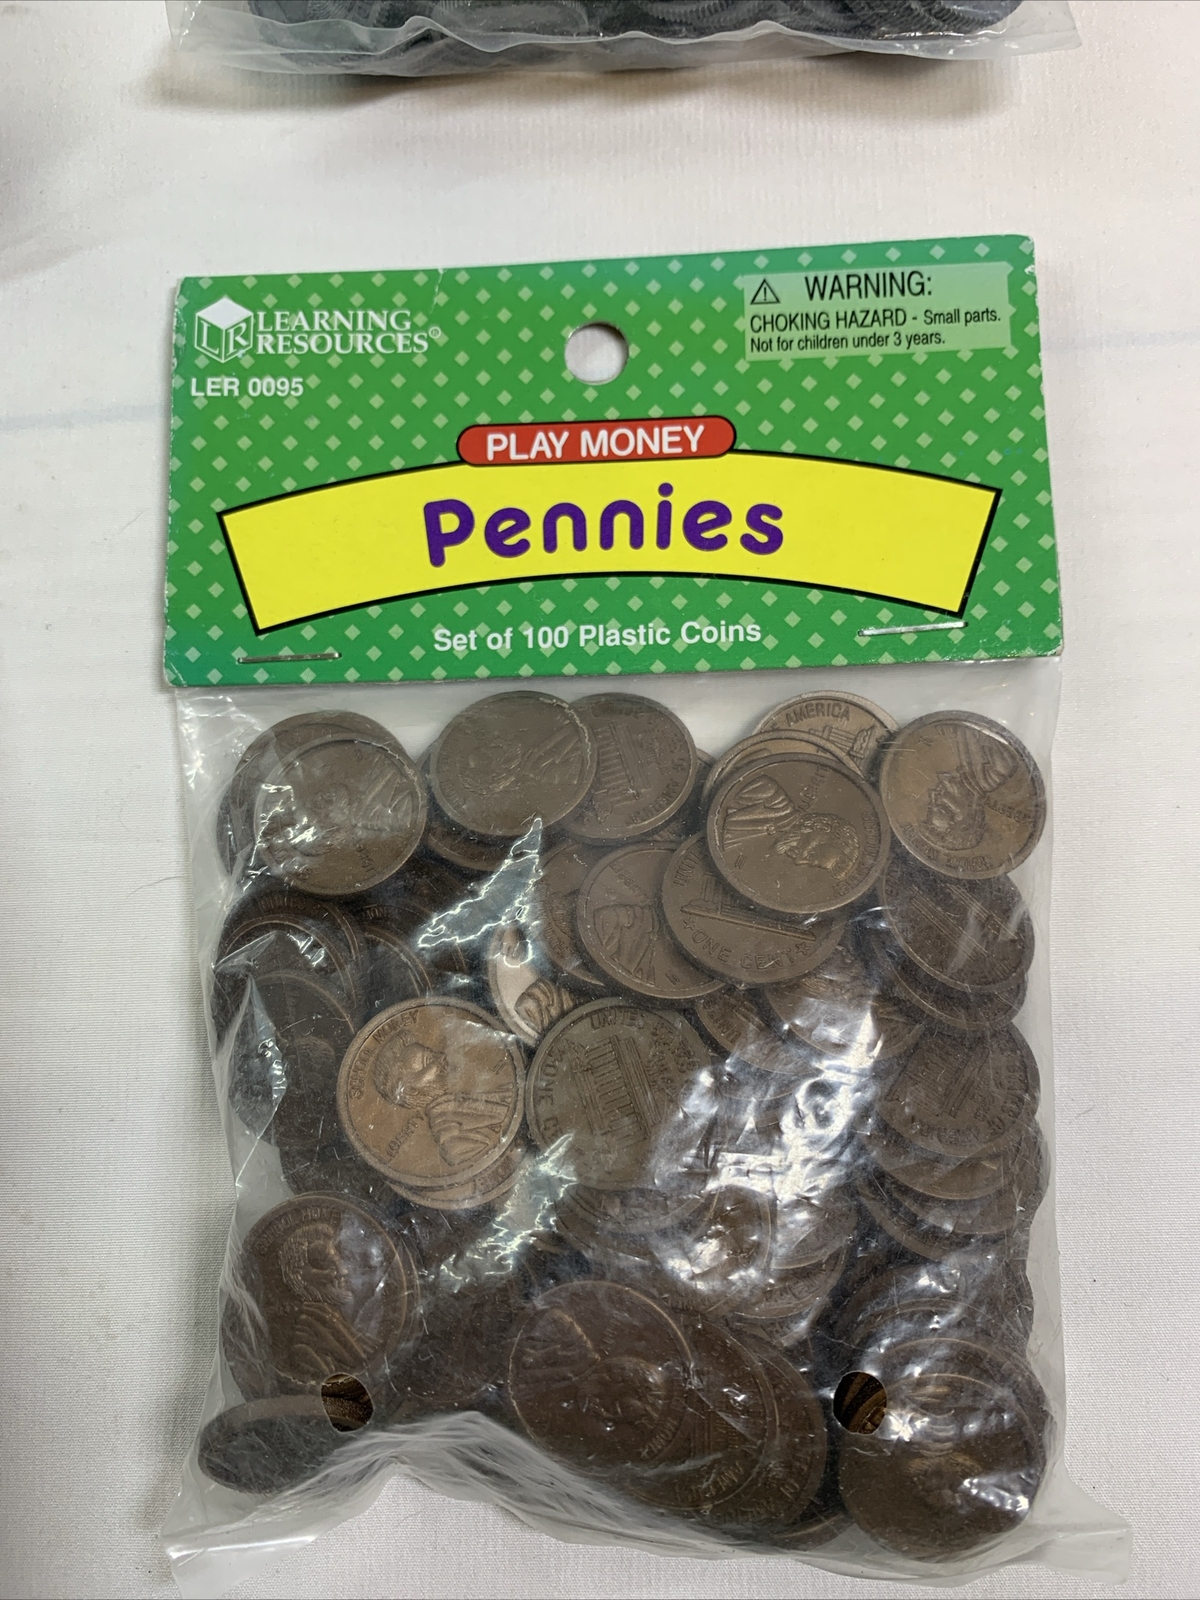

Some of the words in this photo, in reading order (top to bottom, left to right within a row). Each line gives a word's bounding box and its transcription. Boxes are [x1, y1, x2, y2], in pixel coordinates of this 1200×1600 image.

[804, 270, 933, 301] WARNING:
[257, 310, 412, 332] LEARNING
[750, 311, 830, 333] CHOKING
[835, 308, 907, 329] HAZARD
[923, 307, 960, 325] Small
[964, 307, 1001, 326] parts.
[750, 337, 773, 353] Not
[776, 336, 794, 351] for
[797, 334, 848, 350] children
[852, 332, 890, 348] under
[893, 332, 902, 346] 3
[905, 331, 946, 349] years.
[190, 377, 240, 397] LER
[248, 376, 304, 397] 0095
[486, 431, 570, 461] PLAY
[580, 425, 705, 457] MONEY
[423, 482, 784, 567] Pennies
[433, 628, 477, 651] Set
[486, 627, 513, 650] of
[524, 625, 569, 648] 100
[579, 622, 671, 647] Plastic
[680, 620, 762, 644] Coins
[784, 702, 851, 727] AMERICA
[692, 929, 732, 963] ONE
[740, 947, 795, 970] CENT
[373, 1009, 419, 1044] MONEY
